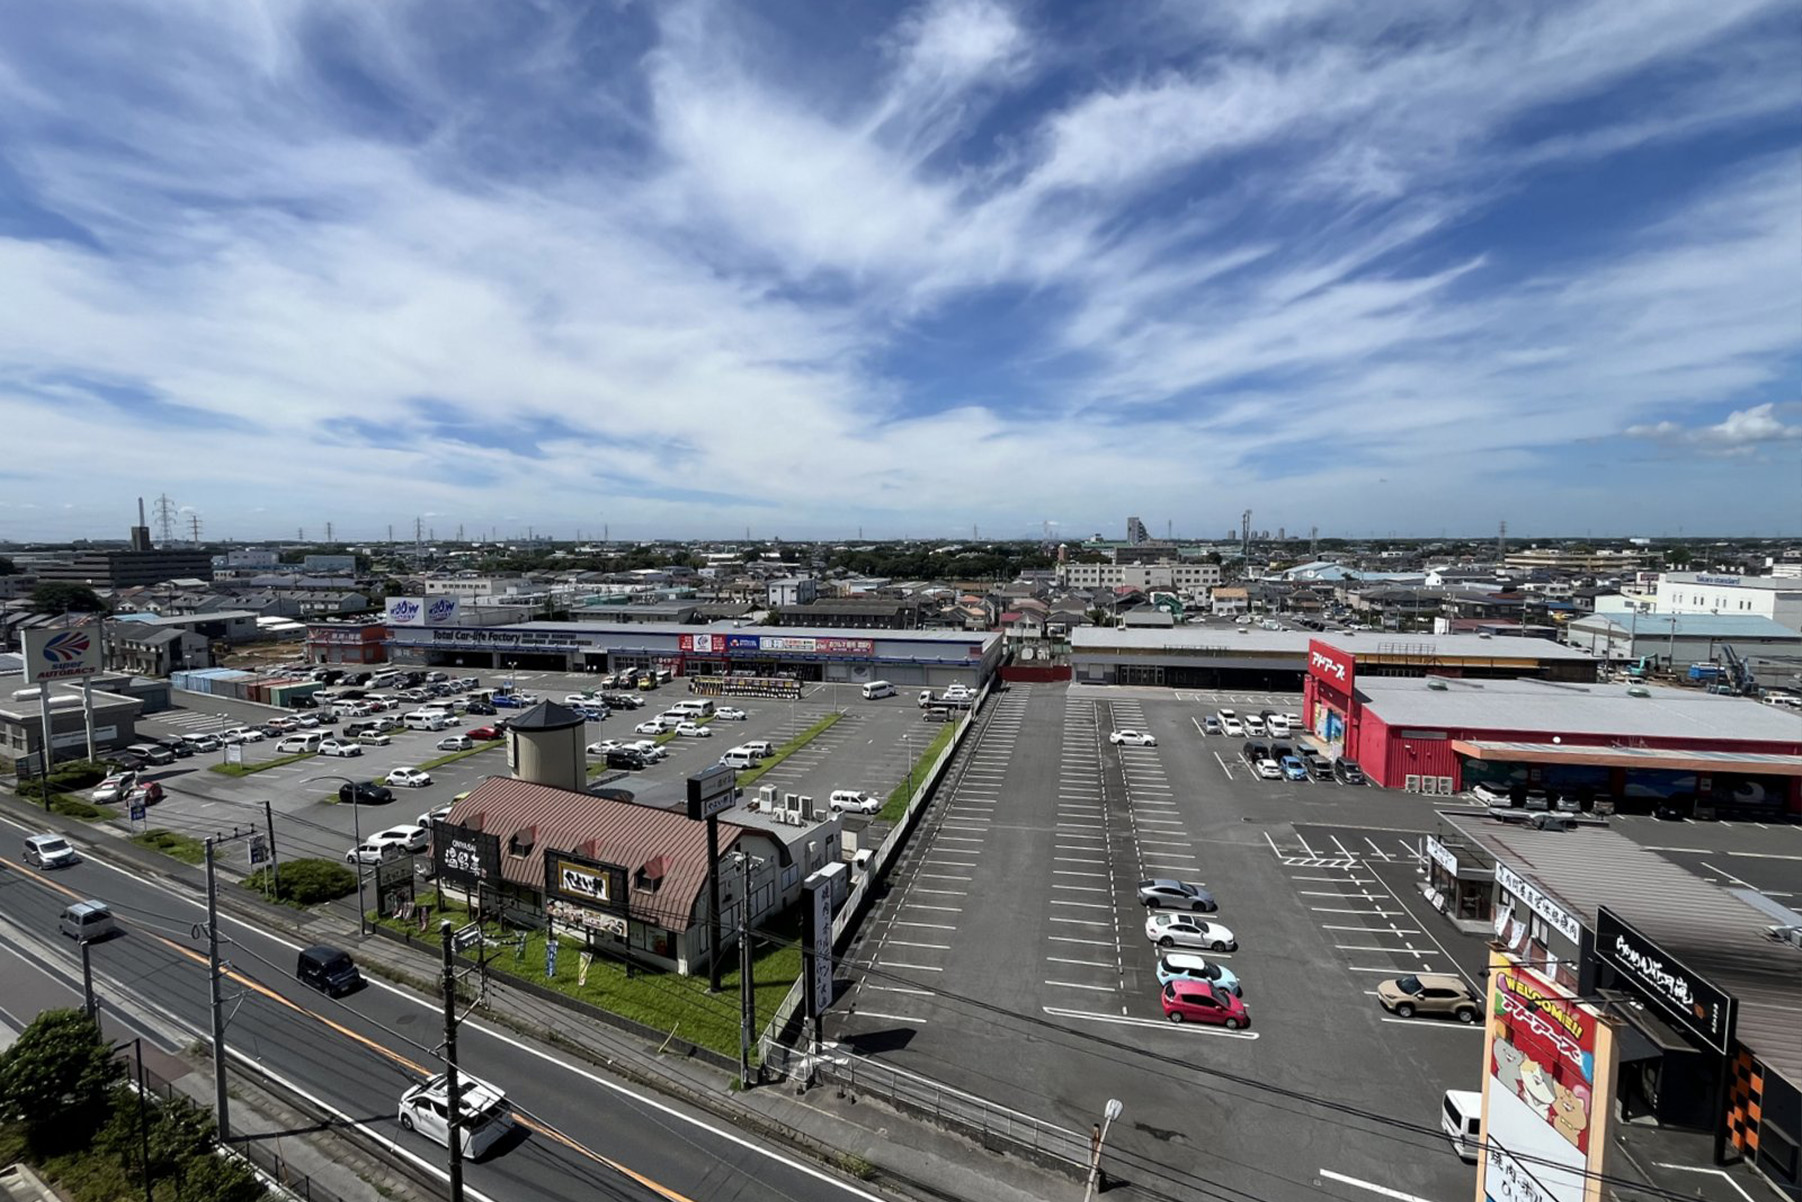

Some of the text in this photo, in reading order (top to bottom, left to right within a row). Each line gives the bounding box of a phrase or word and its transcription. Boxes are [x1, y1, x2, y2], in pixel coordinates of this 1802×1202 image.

[433, 630, 453, 640] Total
[455, 631, 486, 642] Car-life
[488, 631, 519, 643] Factory
[37, 667, 96, 679] AUTOBACS
[1504, 976, 1582, 1039] WELCOME!!
